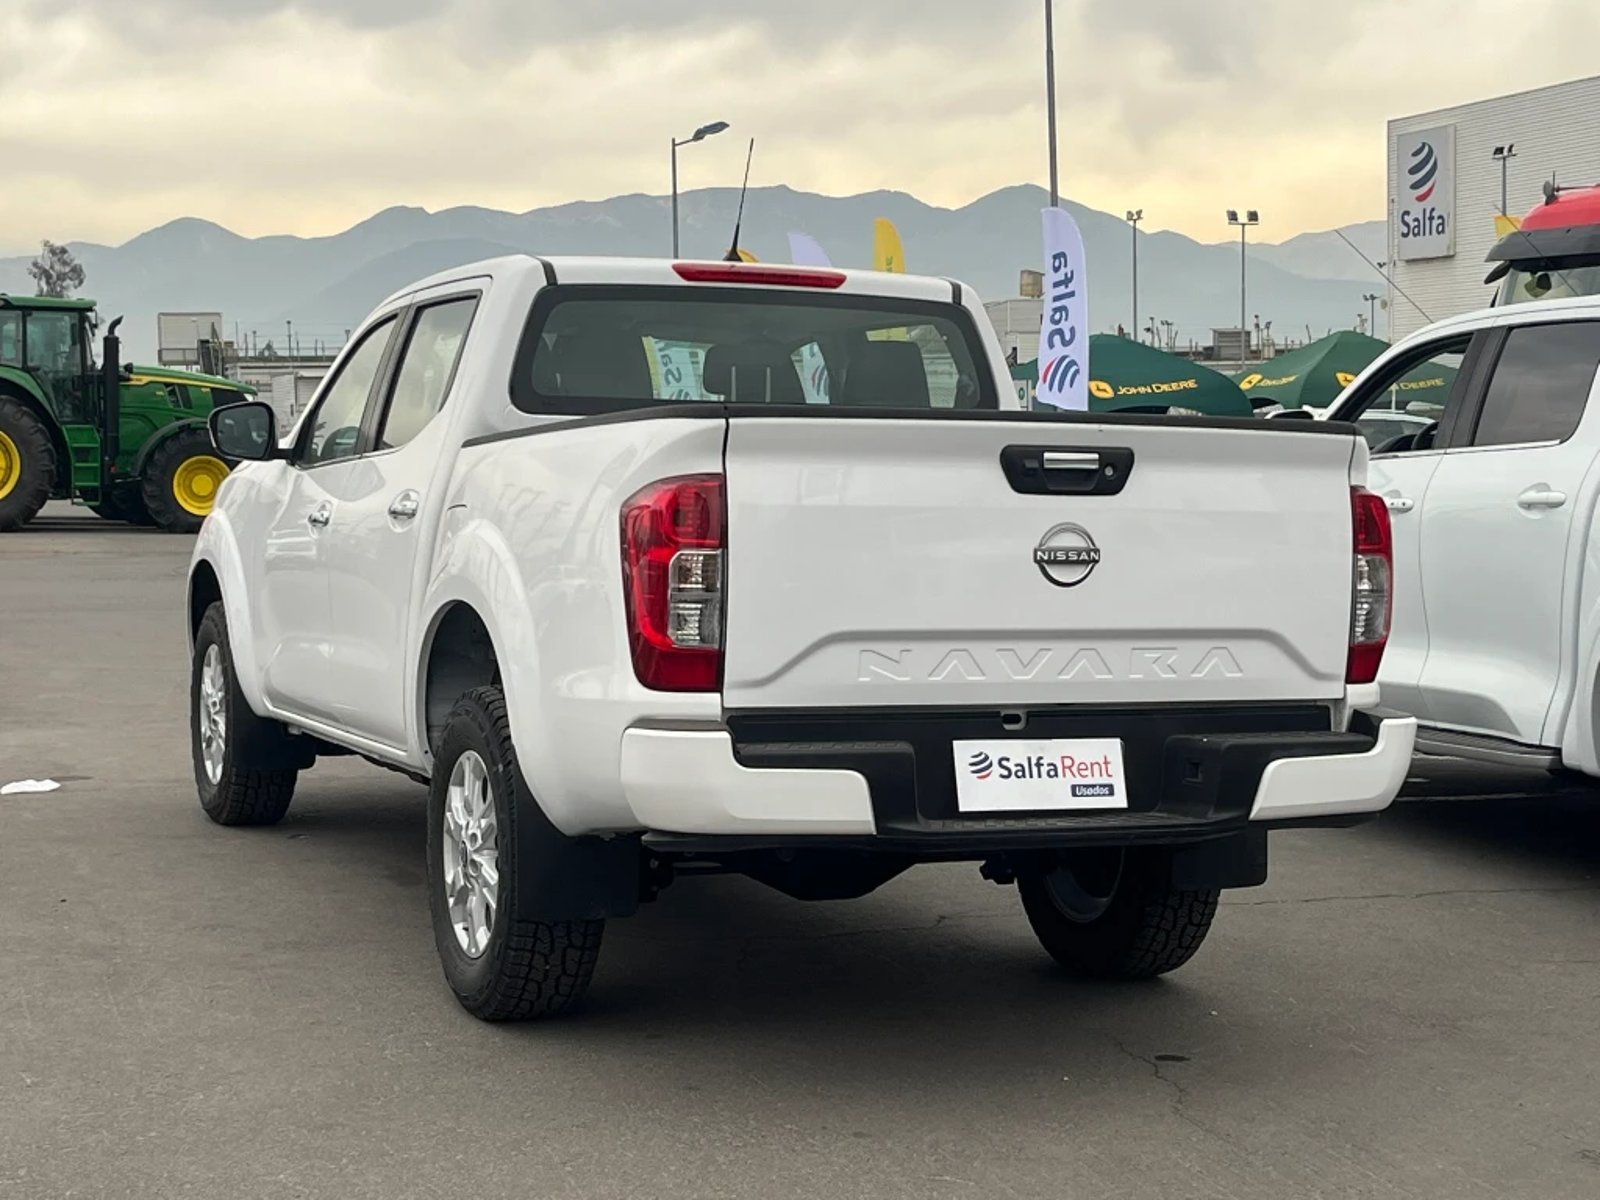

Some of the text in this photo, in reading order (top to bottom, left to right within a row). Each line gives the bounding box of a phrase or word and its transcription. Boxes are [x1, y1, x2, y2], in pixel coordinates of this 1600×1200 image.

[1400, 207, 1446, 238] Salfa
[1117, 379, 1198, 395] JOHN DEERE
[1399, 378, 1445, 390] DEERE
[1036, 551, 1100, 560] NISSAN
[857, 646, 1244, 681] NAVARA
[1075, 785, 1109, 796] Usados
